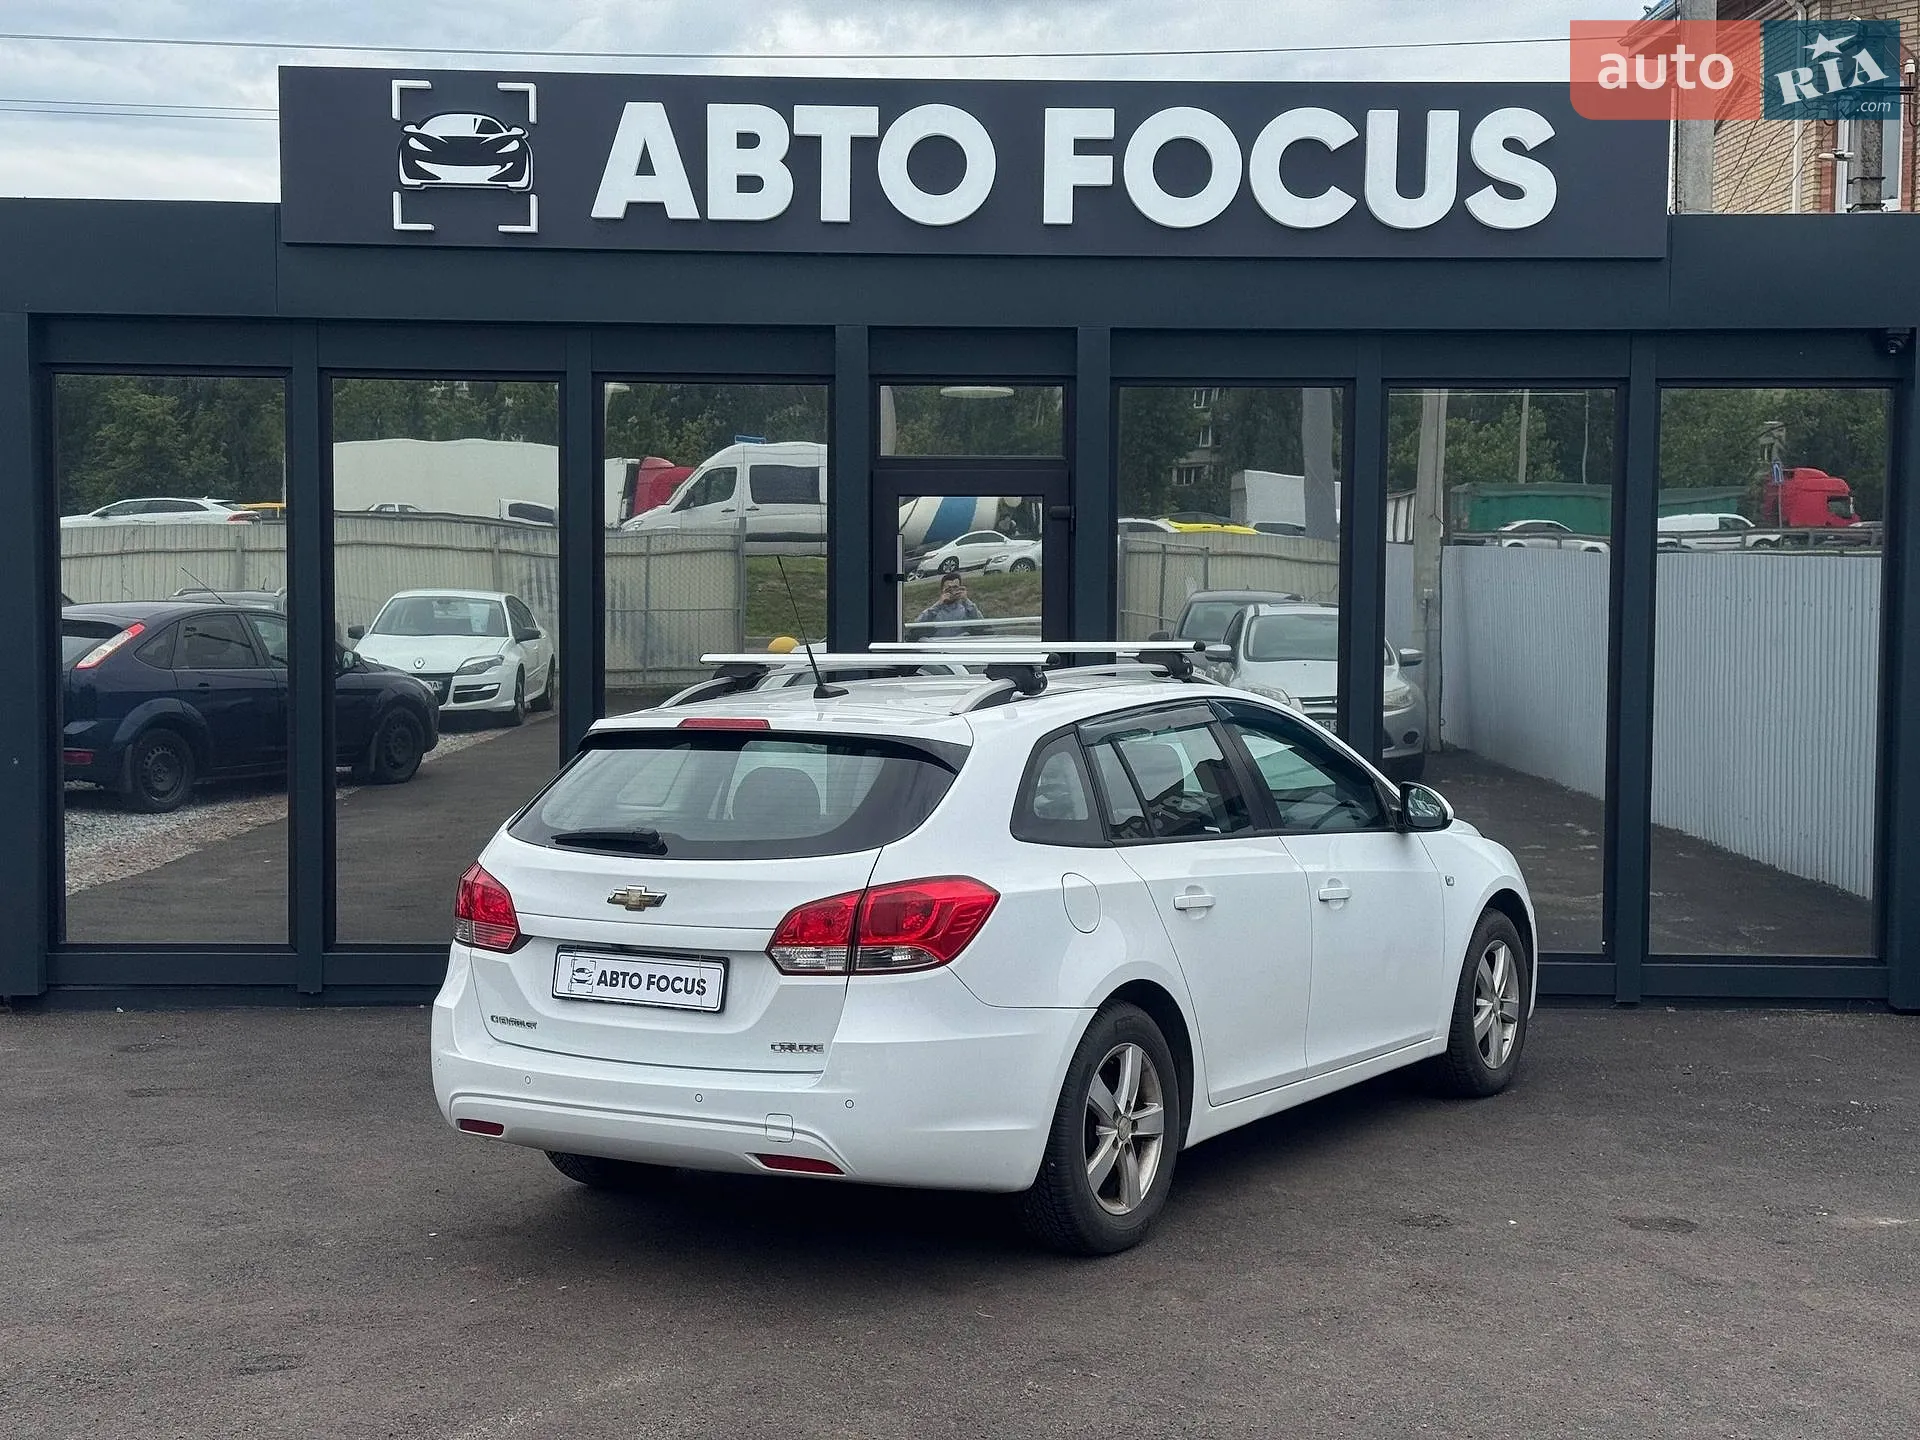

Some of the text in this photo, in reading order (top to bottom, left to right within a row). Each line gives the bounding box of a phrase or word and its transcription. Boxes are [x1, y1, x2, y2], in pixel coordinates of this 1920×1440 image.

[590, 101, 1558, 229] АВТО FOCUS
[597, 969, 707, 996] АВТО FOCUS
